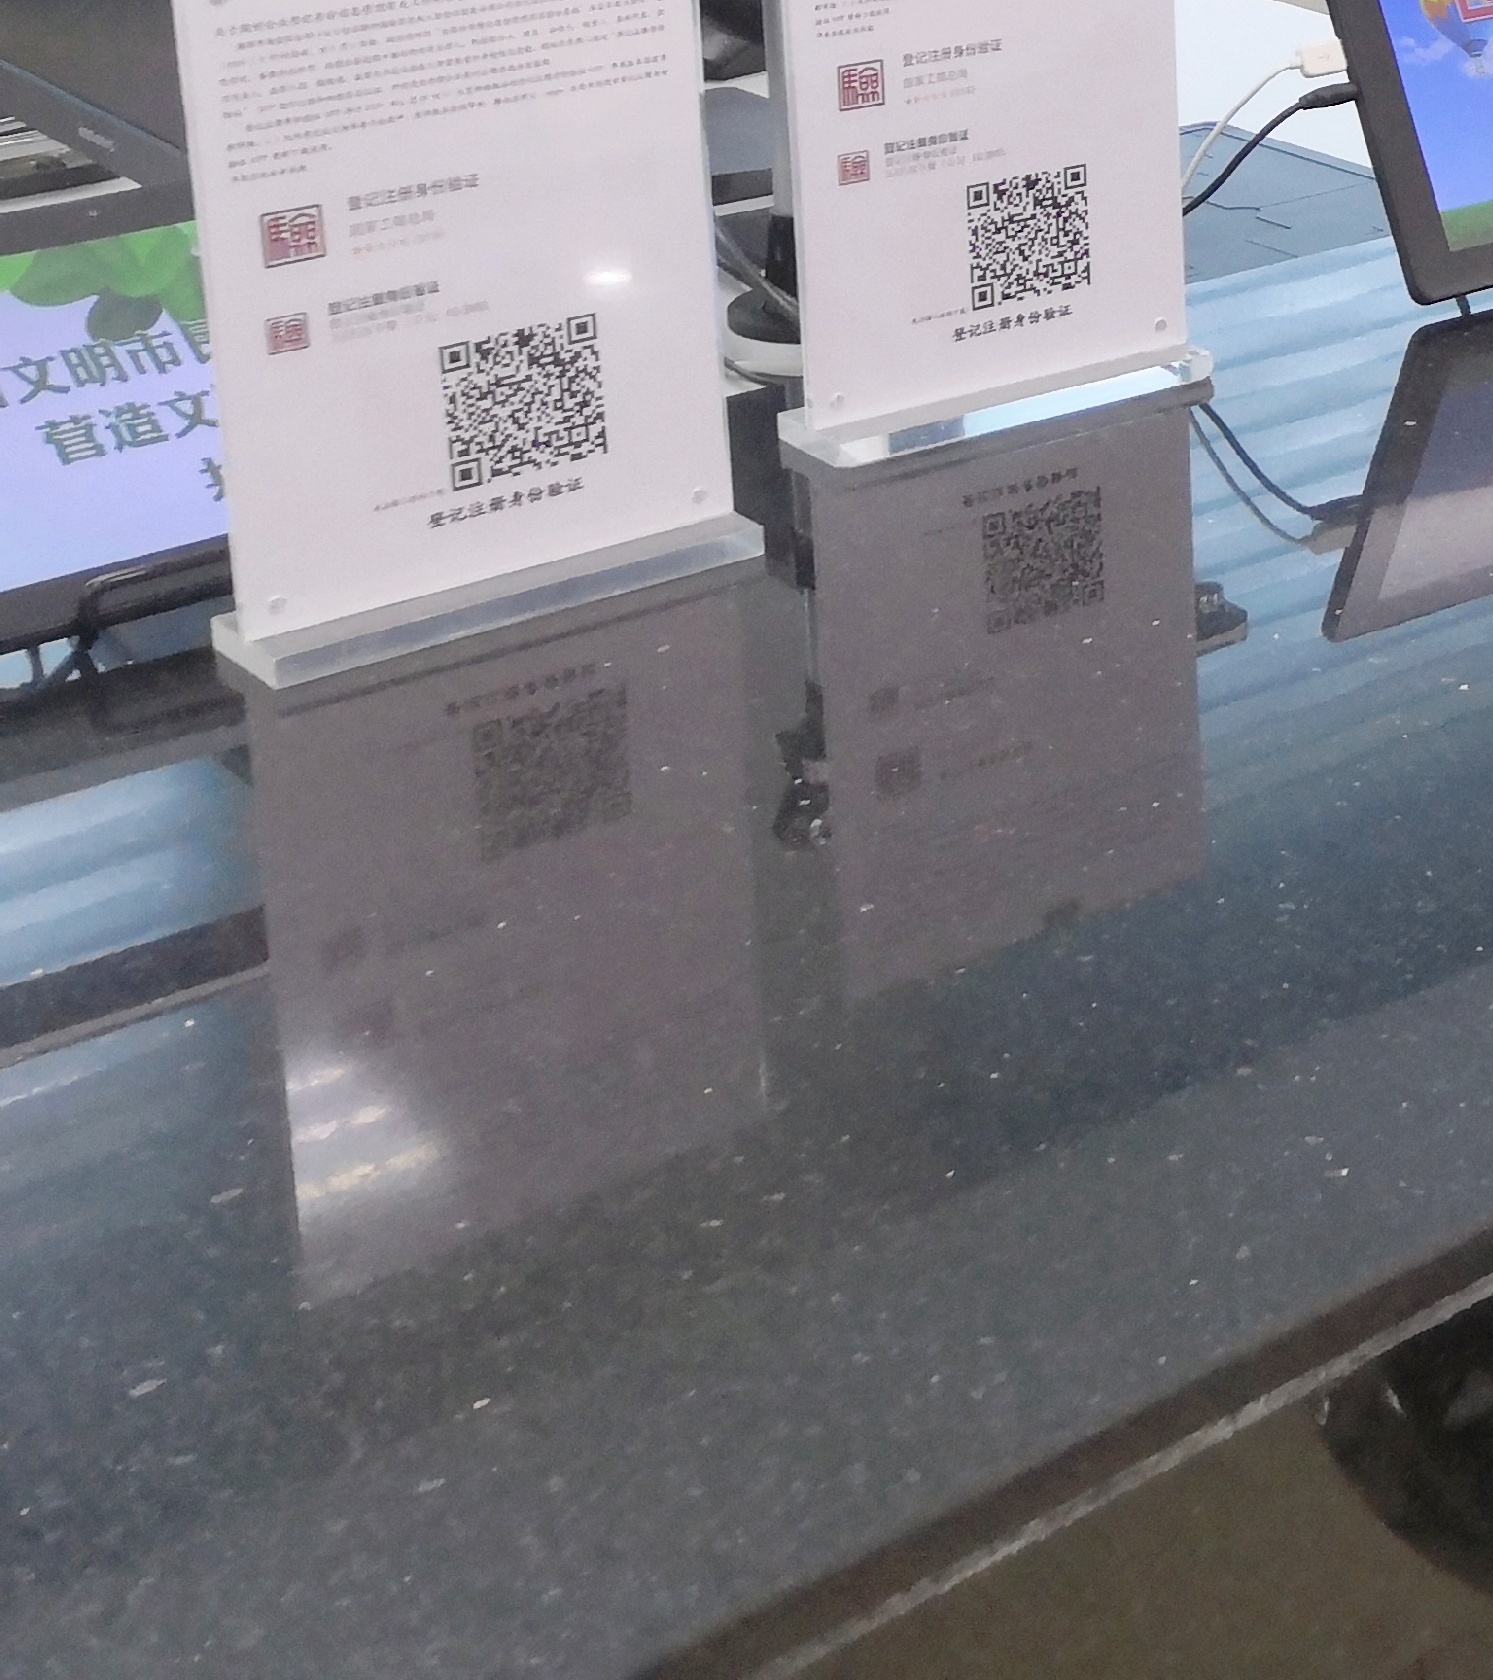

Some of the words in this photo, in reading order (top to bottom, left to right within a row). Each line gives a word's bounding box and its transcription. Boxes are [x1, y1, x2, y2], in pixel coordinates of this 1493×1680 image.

[0, 318, 211, 408] 文明市
[35, 388, 219, 466] 营造文
